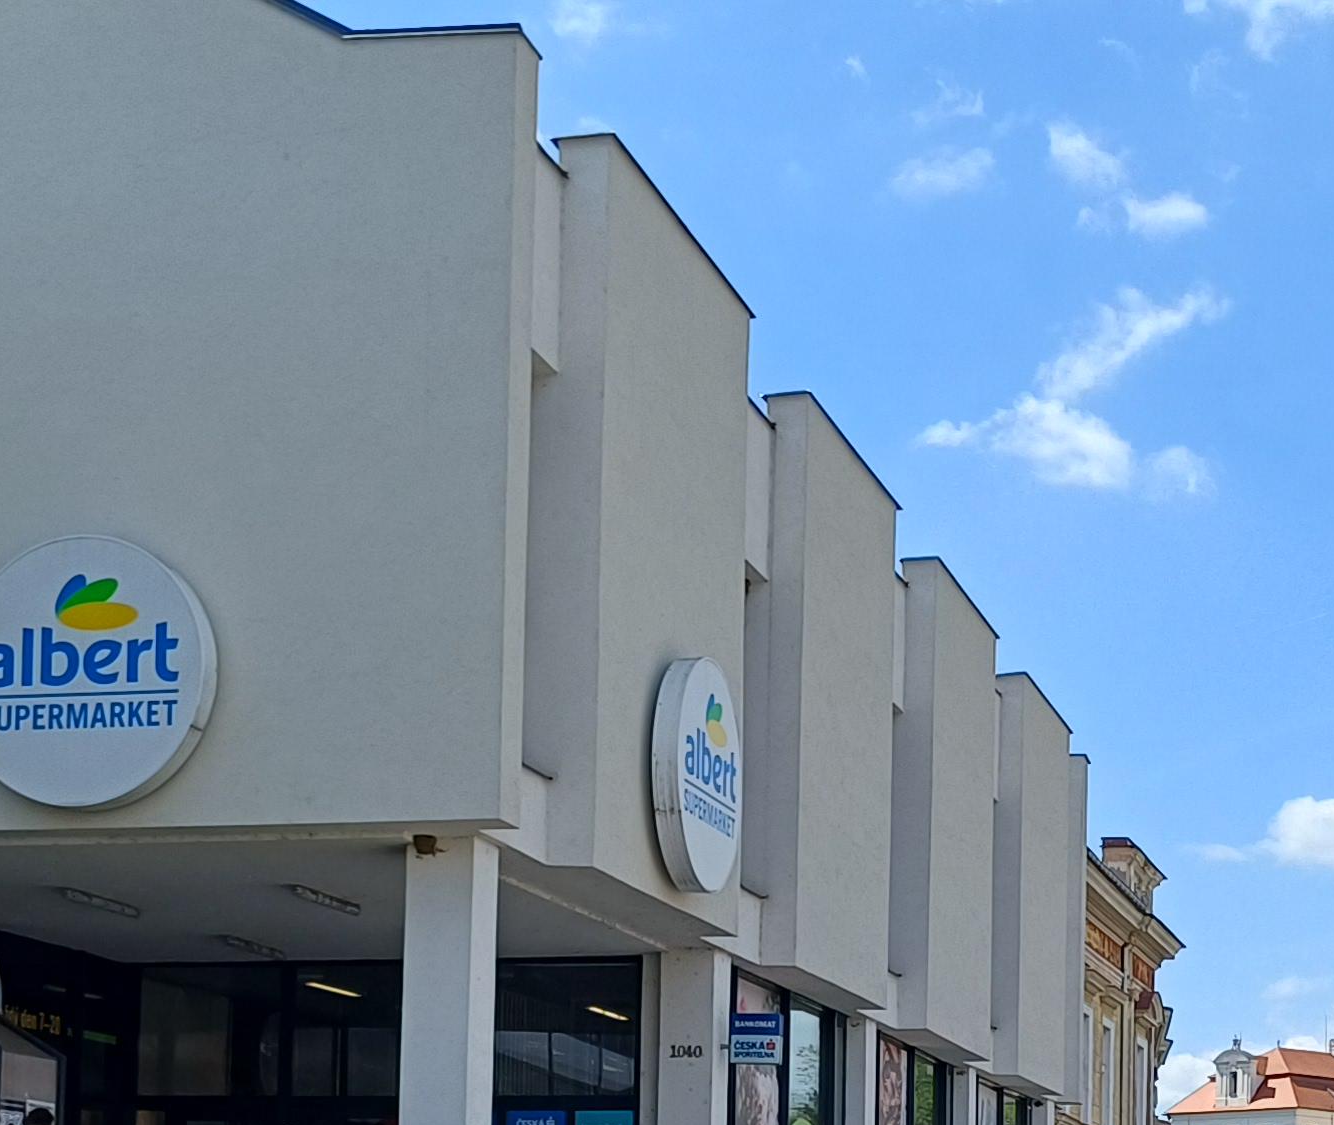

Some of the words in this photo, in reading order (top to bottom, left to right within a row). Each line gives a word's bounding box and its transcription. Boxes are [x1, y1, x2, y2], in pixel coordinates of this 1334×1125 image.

[685, 728, 737, 803] albert
[684, 789, 736, 839] SUPERMARKET
[669, 1045, 703, 1058] 1040
